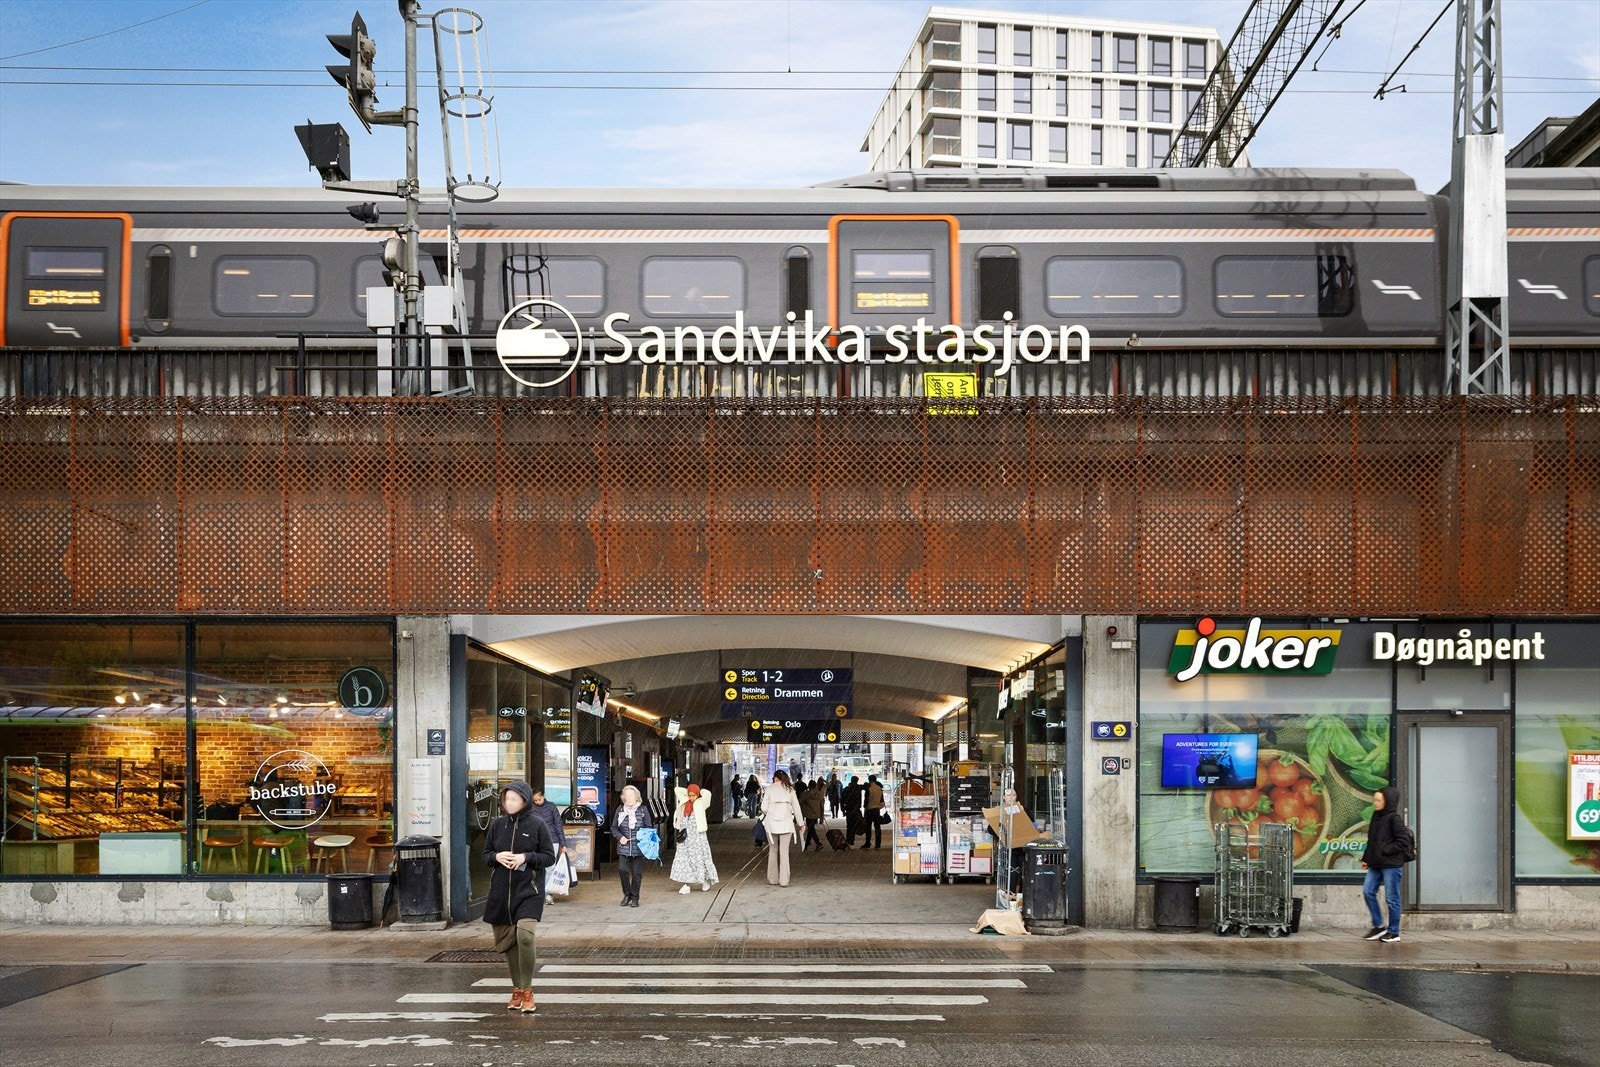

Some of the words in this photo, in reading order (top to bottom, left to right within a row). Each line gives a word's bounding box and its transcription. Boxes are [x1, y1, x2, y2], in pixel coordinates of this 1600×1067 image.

[603, 310, 865, 364] Sandvika
[885, 310, 1090, 377] stasjon
[1176, 616, 1332, 682] joker
[1373, 628, 1545, 666] Døgnåpent
[741, 669, 756, 677] Spor
[762, 670, 783, 683] 1-2
[741, 686, 766, 694] Retning
[774, 688, 823, 698] Drammen
[785, 720, 801, 728] Oslo
[249, 781, 336, 801] backstube
[1321, 833, 1367, 854] joker
